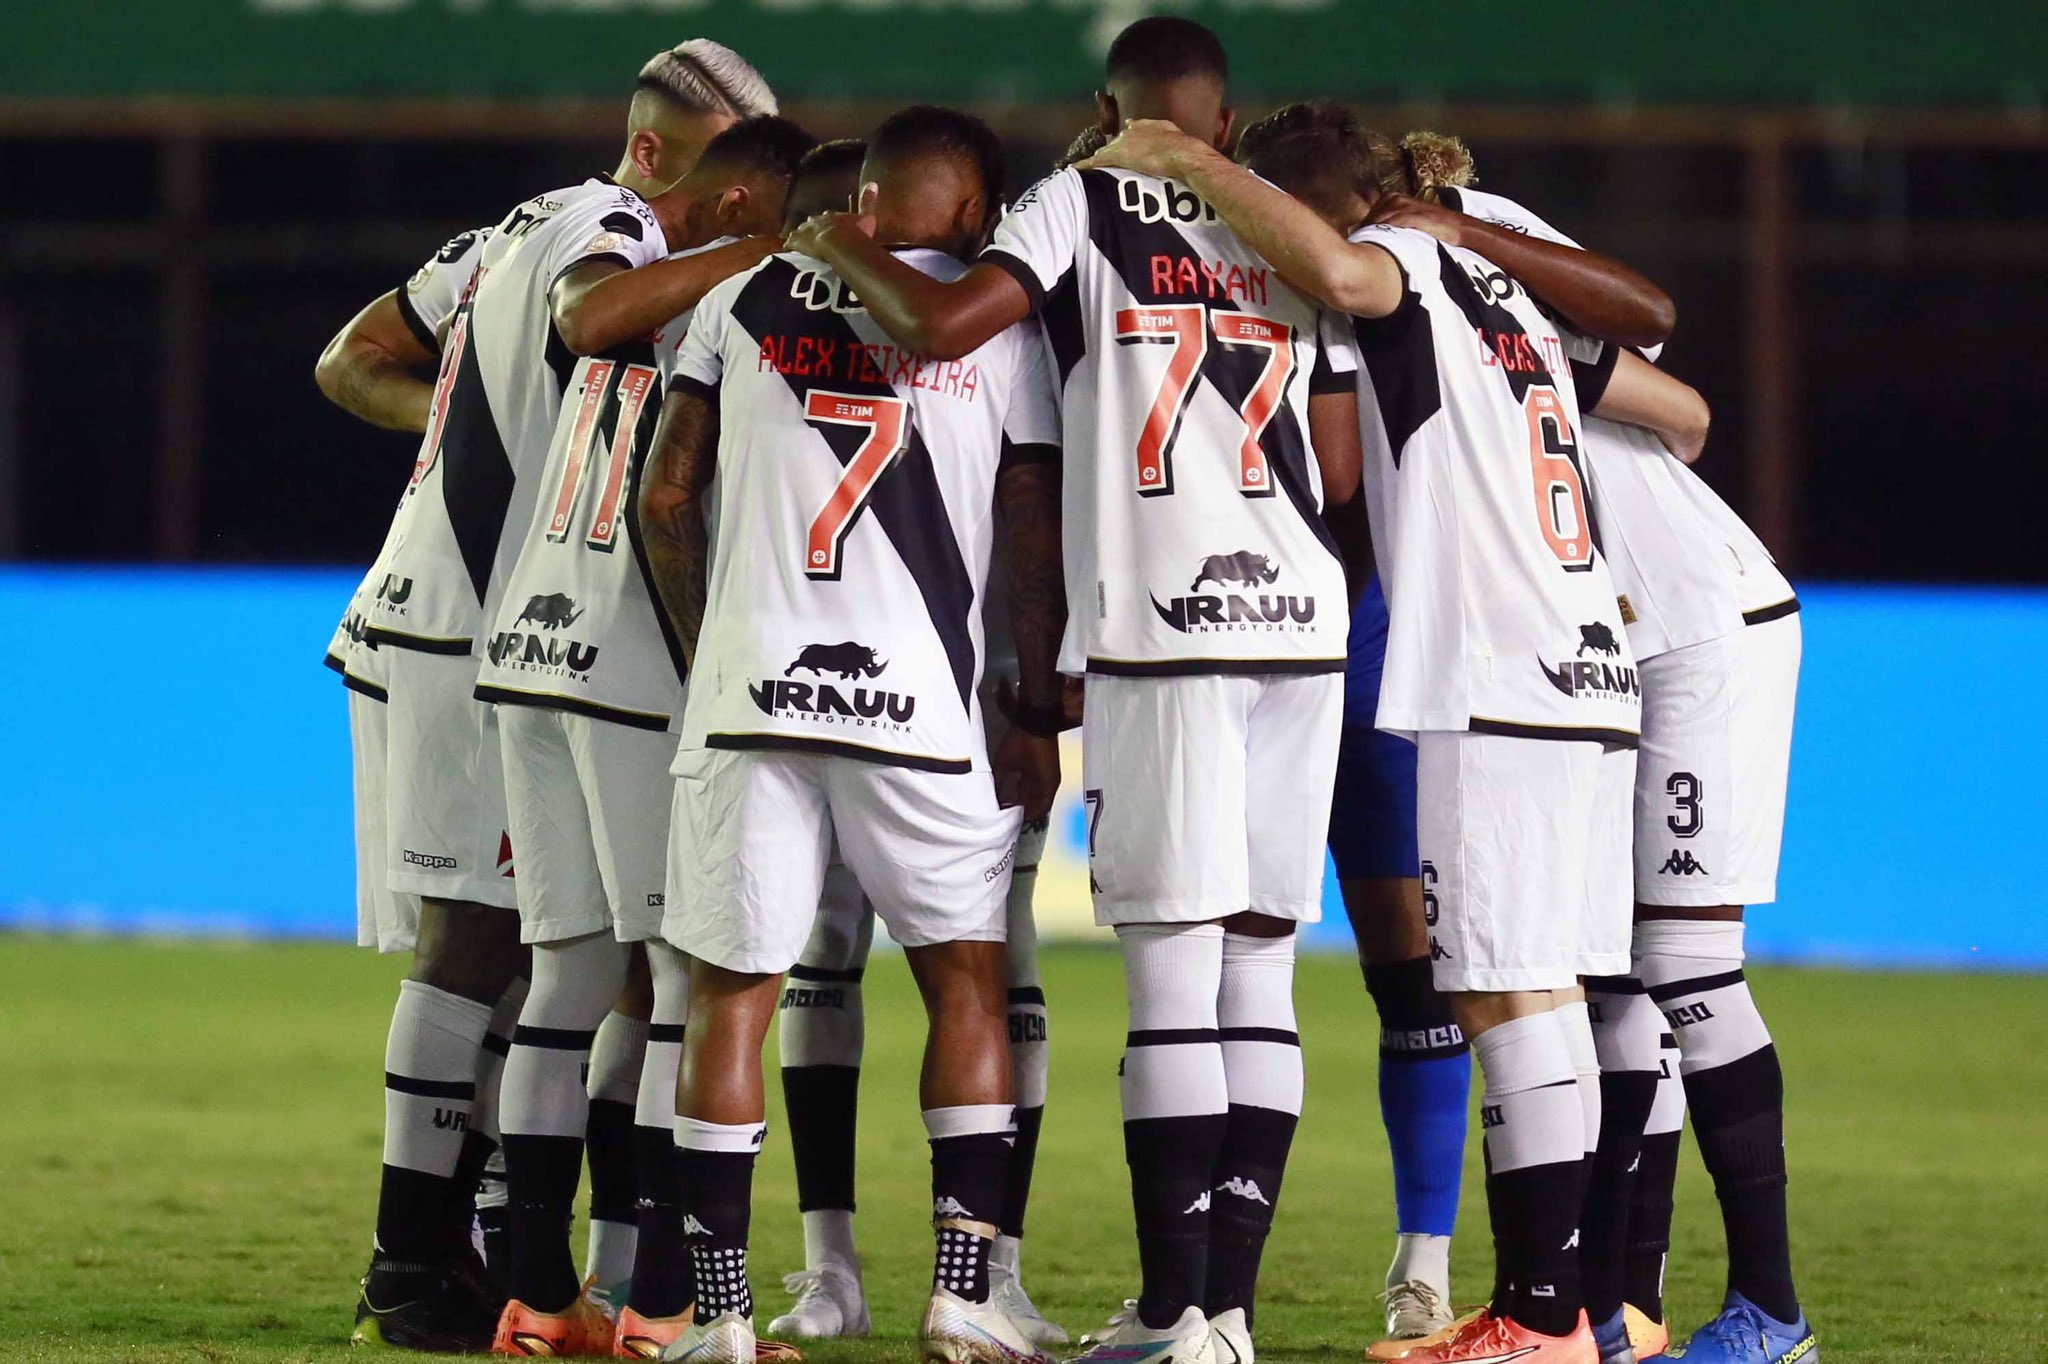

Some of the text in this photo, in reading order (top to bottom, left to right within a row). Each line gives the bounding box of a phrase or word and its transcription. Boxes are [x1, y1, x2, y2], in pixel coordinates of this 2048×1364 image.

[1151, 254, 1267, 306] RAYAN
[1152, 316, 1174, 327] TIM
[1253, 325, 1272, 337] TIM
[758, 335, 978, 402] ALEX TEIXEIRA
[1115, 303, 1299, 498] 77
[851, 405, 874, 417] TIM
[546, 356, 658, 553] 11
[804, 389, 913, 581] 7
[1521, 383, 1597, 572] 6
[1666, 772, 1703, 838] 3
[404, 850, 456, 868] Kappa
